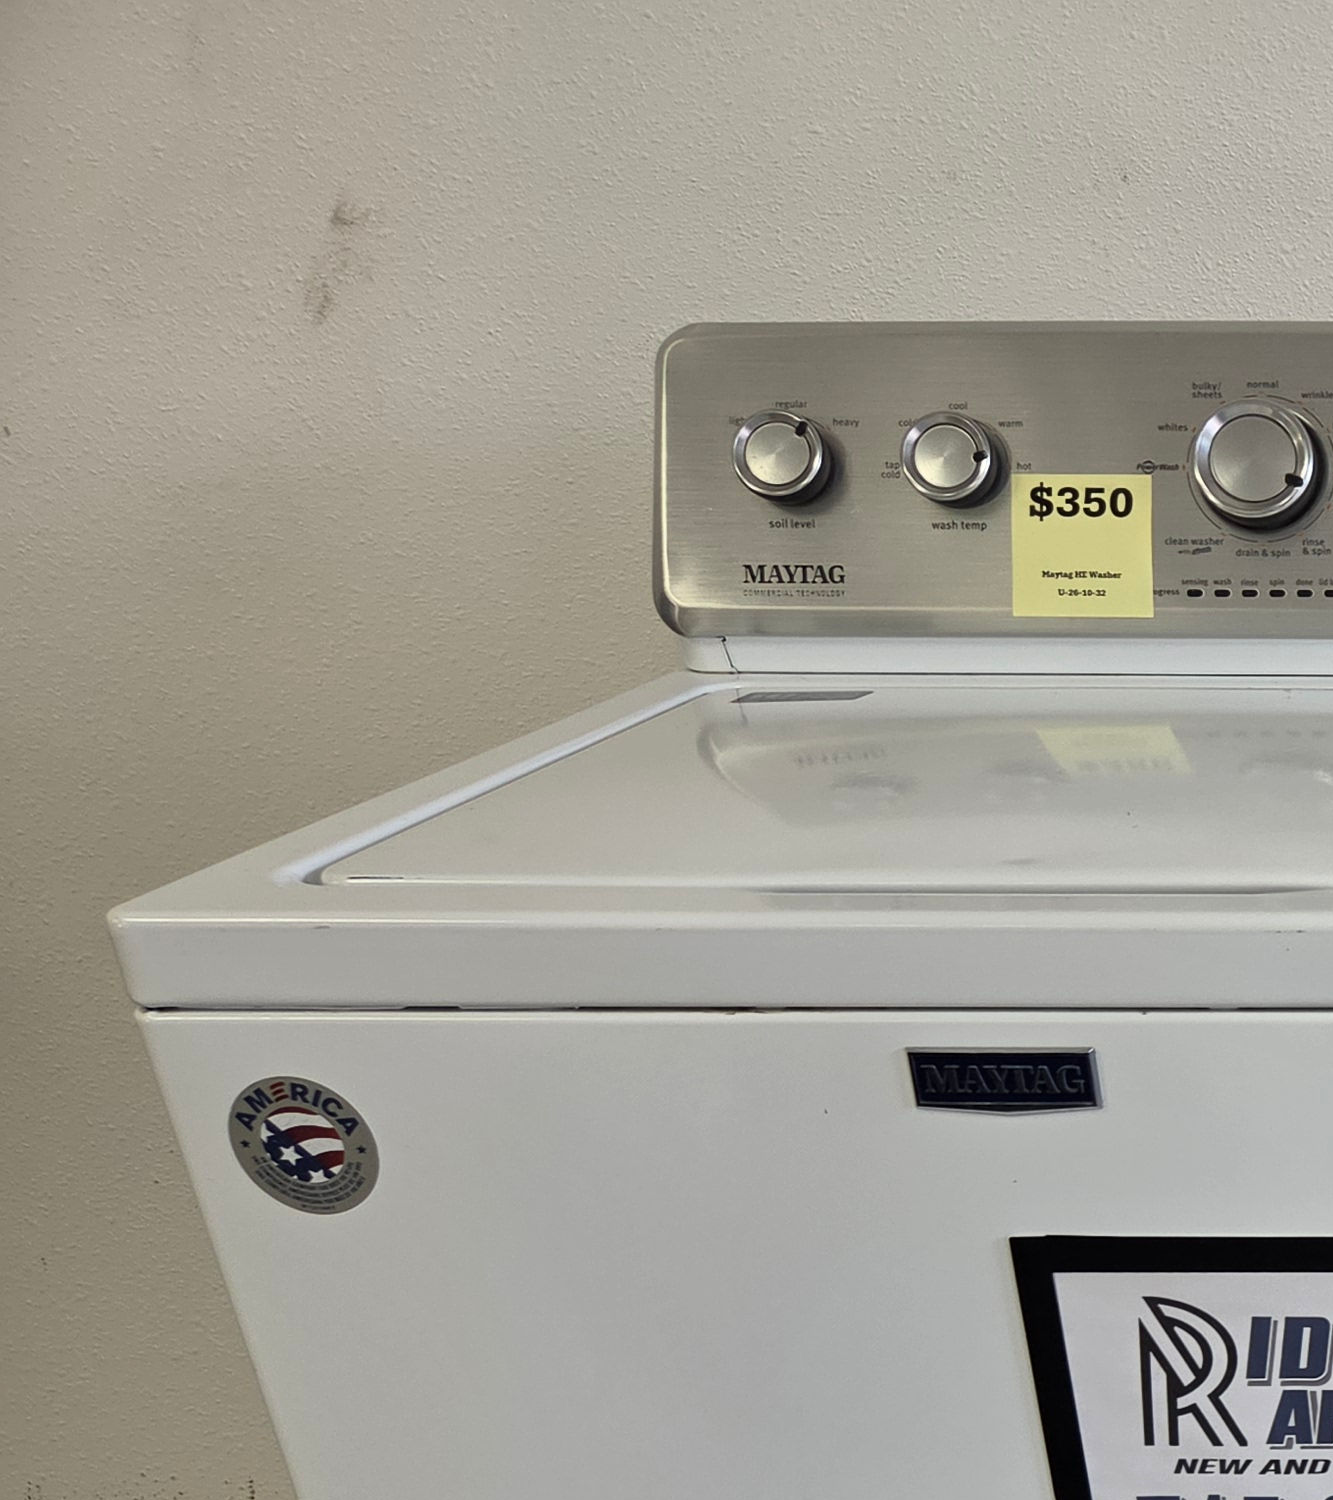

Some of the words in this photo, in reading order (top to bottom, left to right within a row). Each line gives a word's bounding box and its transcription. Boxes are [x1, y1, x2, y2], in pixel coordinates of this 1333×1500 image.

[1192, 381, 1222, 391] bulky/
[1246, 380, 1279, 389] normal
[1192, 390, 1222, 399] sheets
[1301, 391, 1333, 399] wrinkle
[775, 400, 807, 410] regular
[948, 401, 968, 410] cool
[833, 417, 859, 428] heavy
[998, 420, 1023, 428] warm
[1157, 423, 1188, 432] whites
[884, 461, 901, 471] tap
[1016, 461, 1031, 471] hot
[881, 470, 901, 479] cold
[1029, 482, 1133, 522] $350
[769, 518, 788, 529] soil
[791, 518, 816, 529] level
[931, 520, 958, 530] wash
[961, 520, 988, 532] temp
[1165, 537, 1189, 546] clean
[1191, 537, 1225, 546] washer
[1302, 538, 1325, 546] rinse
[1235, 548, 1259, 557] drain
[1261, 549, 1269, 557] &
[1271, 548, 1291, 559] spin
[1302, 547, 1310, 555] &
[1312, 547, 1332, 557] spin
[742, 564, 846, 584] MAYTAG
[1042, 571, 1073, 580] Maytag
[1089, 571, 1122, 579] Washer
[1269, 578, 1285, 587] spin
[1058, 588, 1106, 597] U-26-10-32
[919, 1064, 1086, 1095] MAYTAG
[235, 1081, 360, 1137] AMERICA
[1173, 1458, 1253, 1474] NEW
[1259, 1458, 1332, 1475] AND
